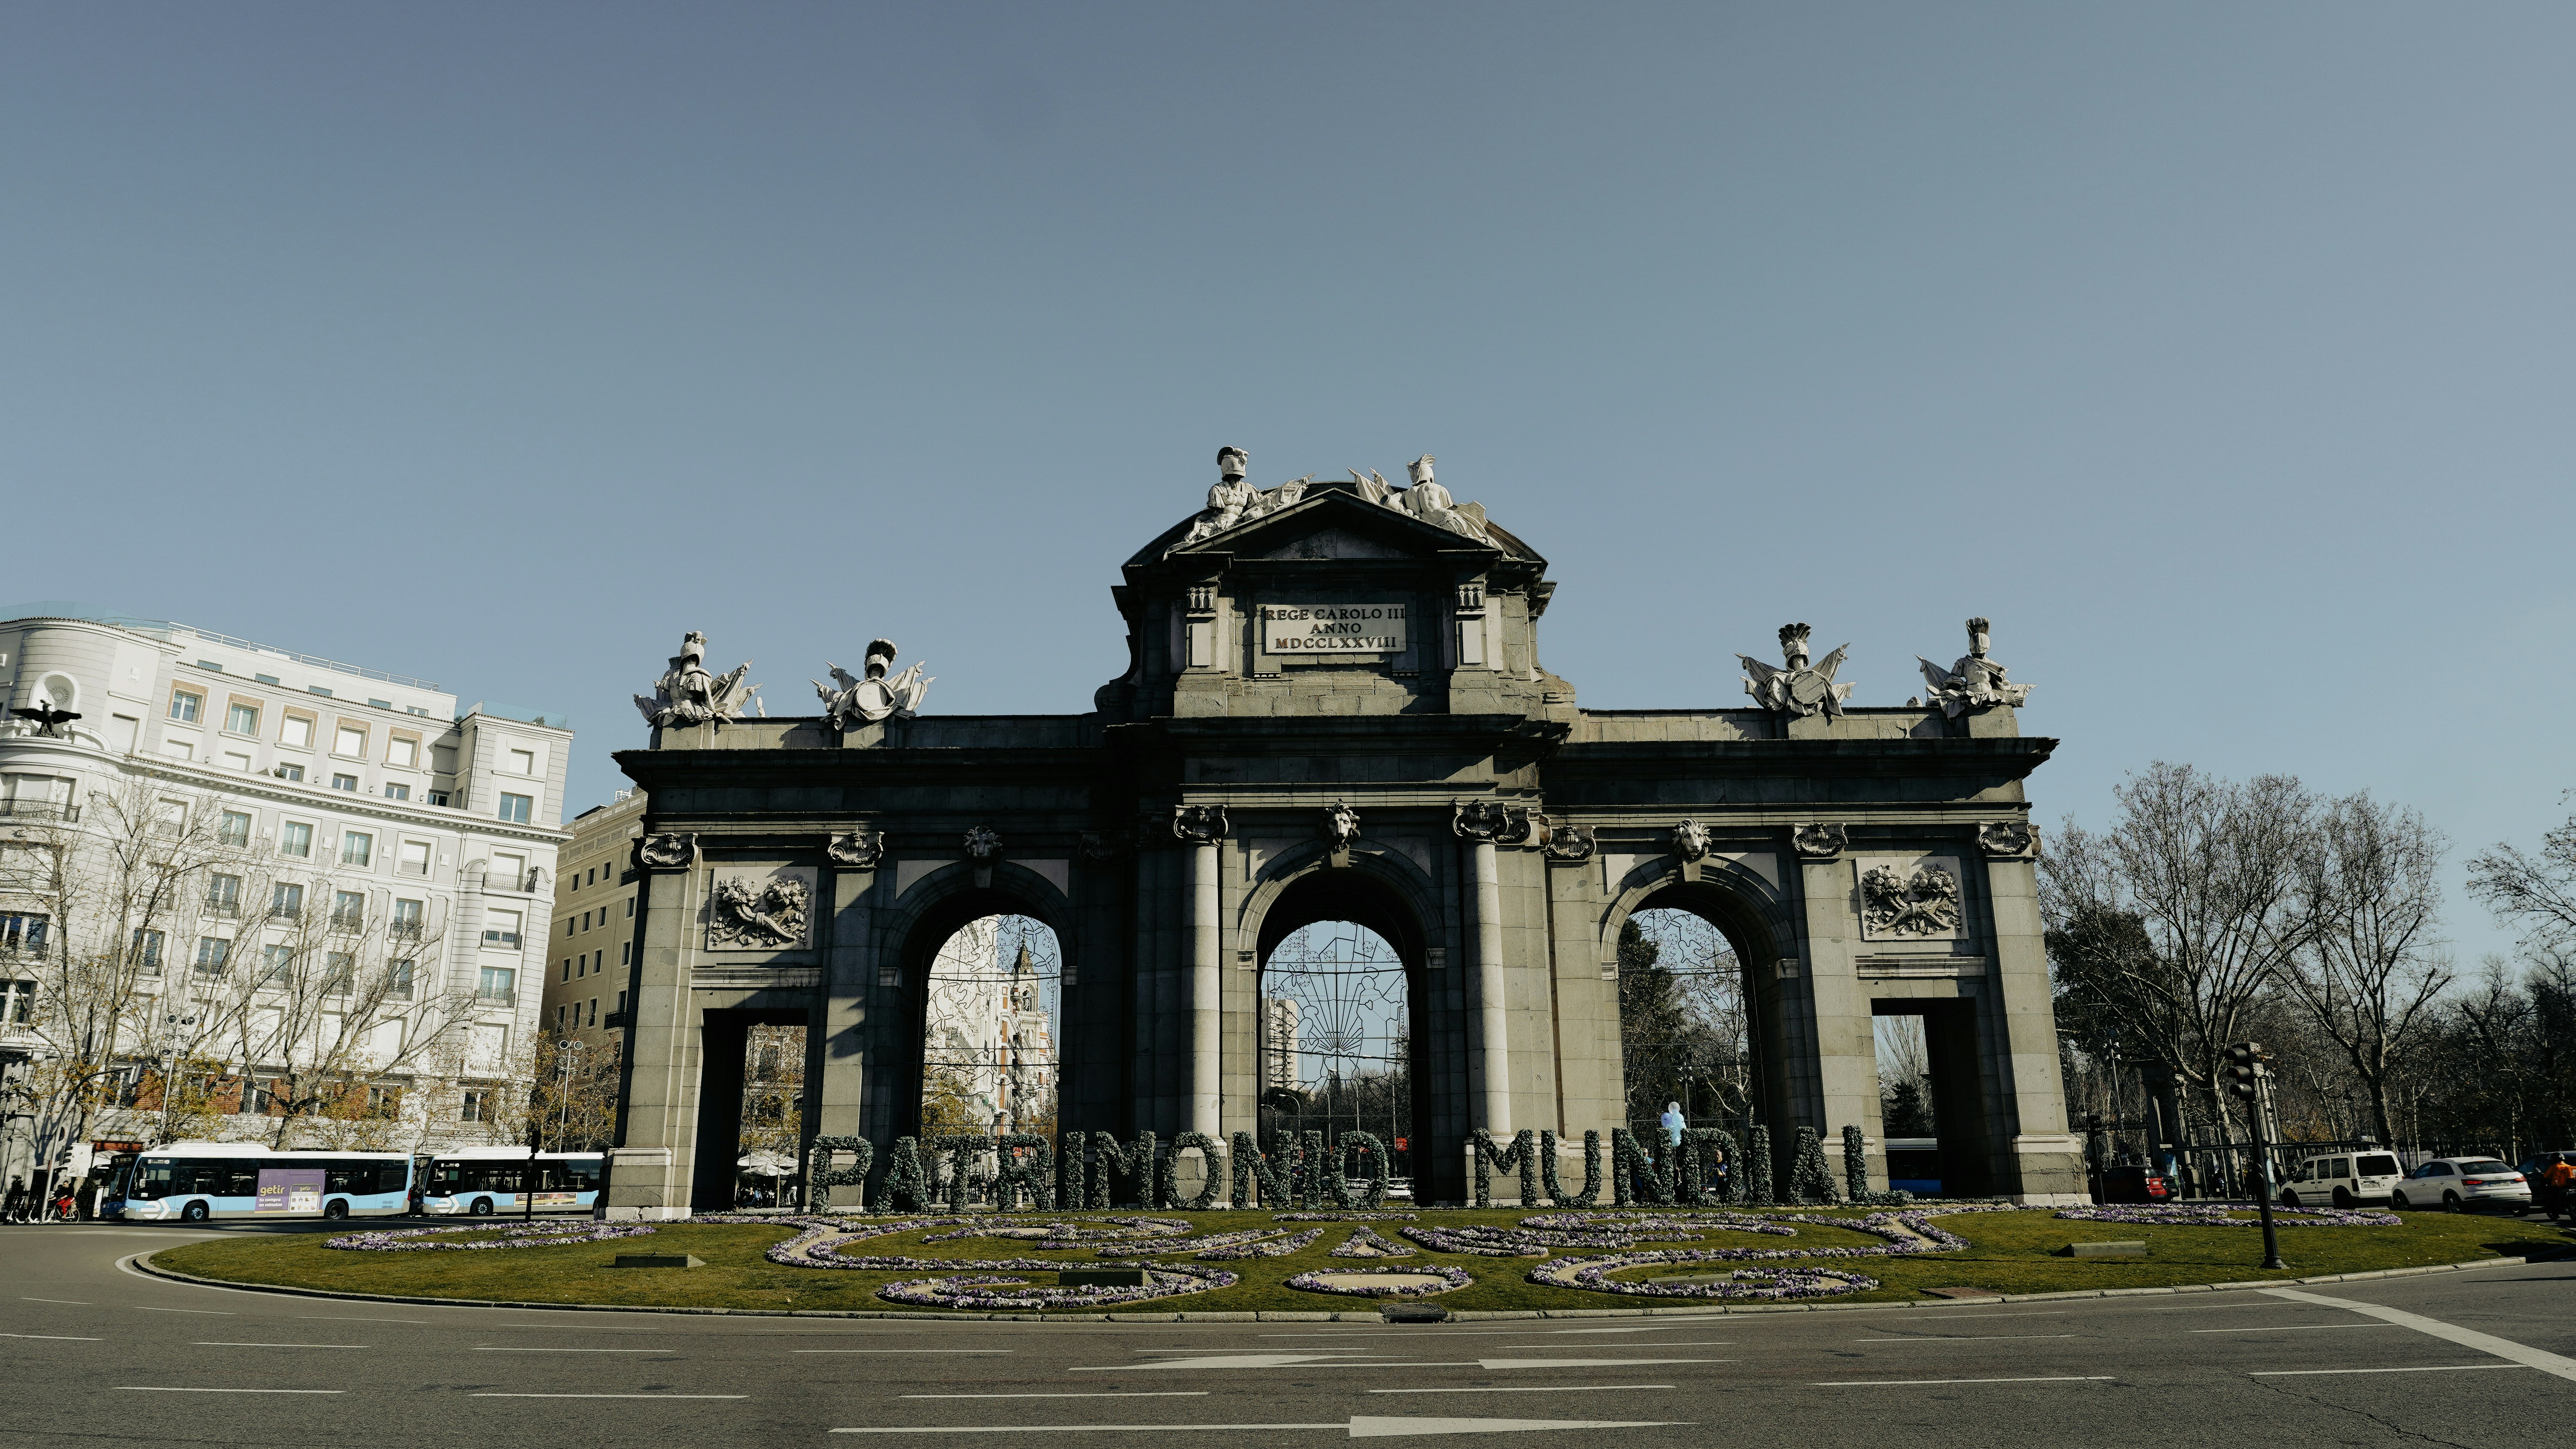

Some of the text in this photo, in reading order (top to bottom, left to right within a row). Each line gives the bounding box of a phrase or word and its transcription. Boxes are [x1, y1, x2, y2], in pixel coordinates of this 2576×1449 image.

[1266, 608, 1405, 621] REGE CAROLO III
[1309, 623, 1361, 635] ANNO
[1274, 637, 1397, 649] MDCCLXXVIII
[809, 1123, 1914, 1214] PATRIMONIO MUNDIAL
[260, 1185, 285, 1197] getir
